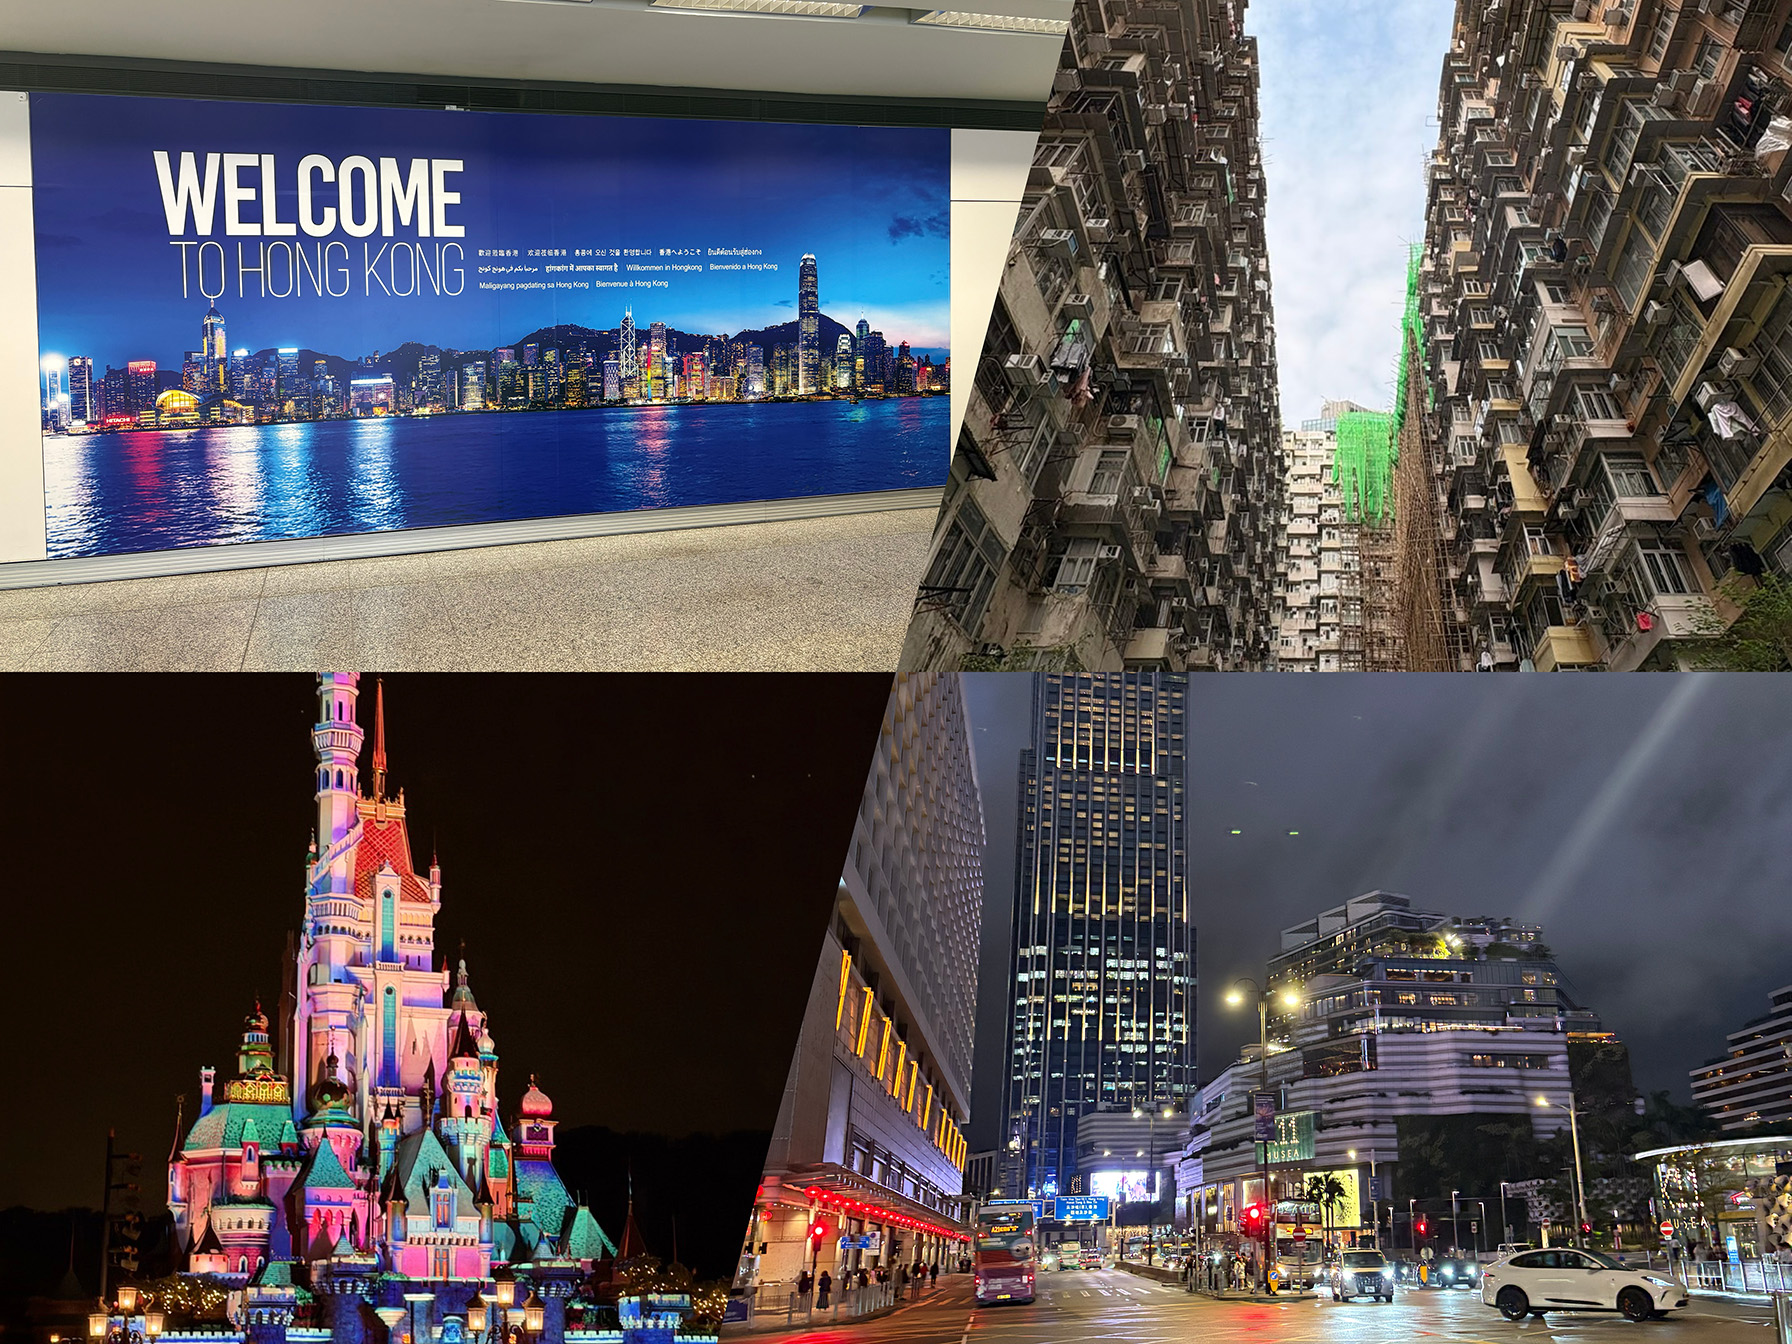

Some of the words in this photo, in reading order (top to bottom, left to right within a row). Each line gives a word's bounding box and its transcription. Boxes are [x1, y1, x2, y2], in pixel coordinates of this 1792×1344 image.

[153, 150, 466, 238] WELCOME
[595, 248, 607, 257] 오신
[609, 248, 621, 257] 것을
[623, 248, 652, 257] 환영합니다
[659, 248, 701, 256] 香港へようこそ
[169, 241, 226, 299] TO
[238, 241, 350, 298] HONG
[364, 242, 465, 297] KONG
[626, 263, 663, 271] Willkommen
[664, 263, 671, 271] in
[671, 263, 703, 273] Hongkong
[709, 263, 741, 271] Bienvenido
[747, 263, 762, 271] Hong
[763, 262, 778, 271] Kong
[479, 282, 515, 291] Maligayang
[516, 282, 546, 290] pagdating
[555, 281, 572, 289] Hong
[573, 280, 589, 290] Kong
[635, 280, 651, 288] Hong
[652, 279, 669, 288] Kong
